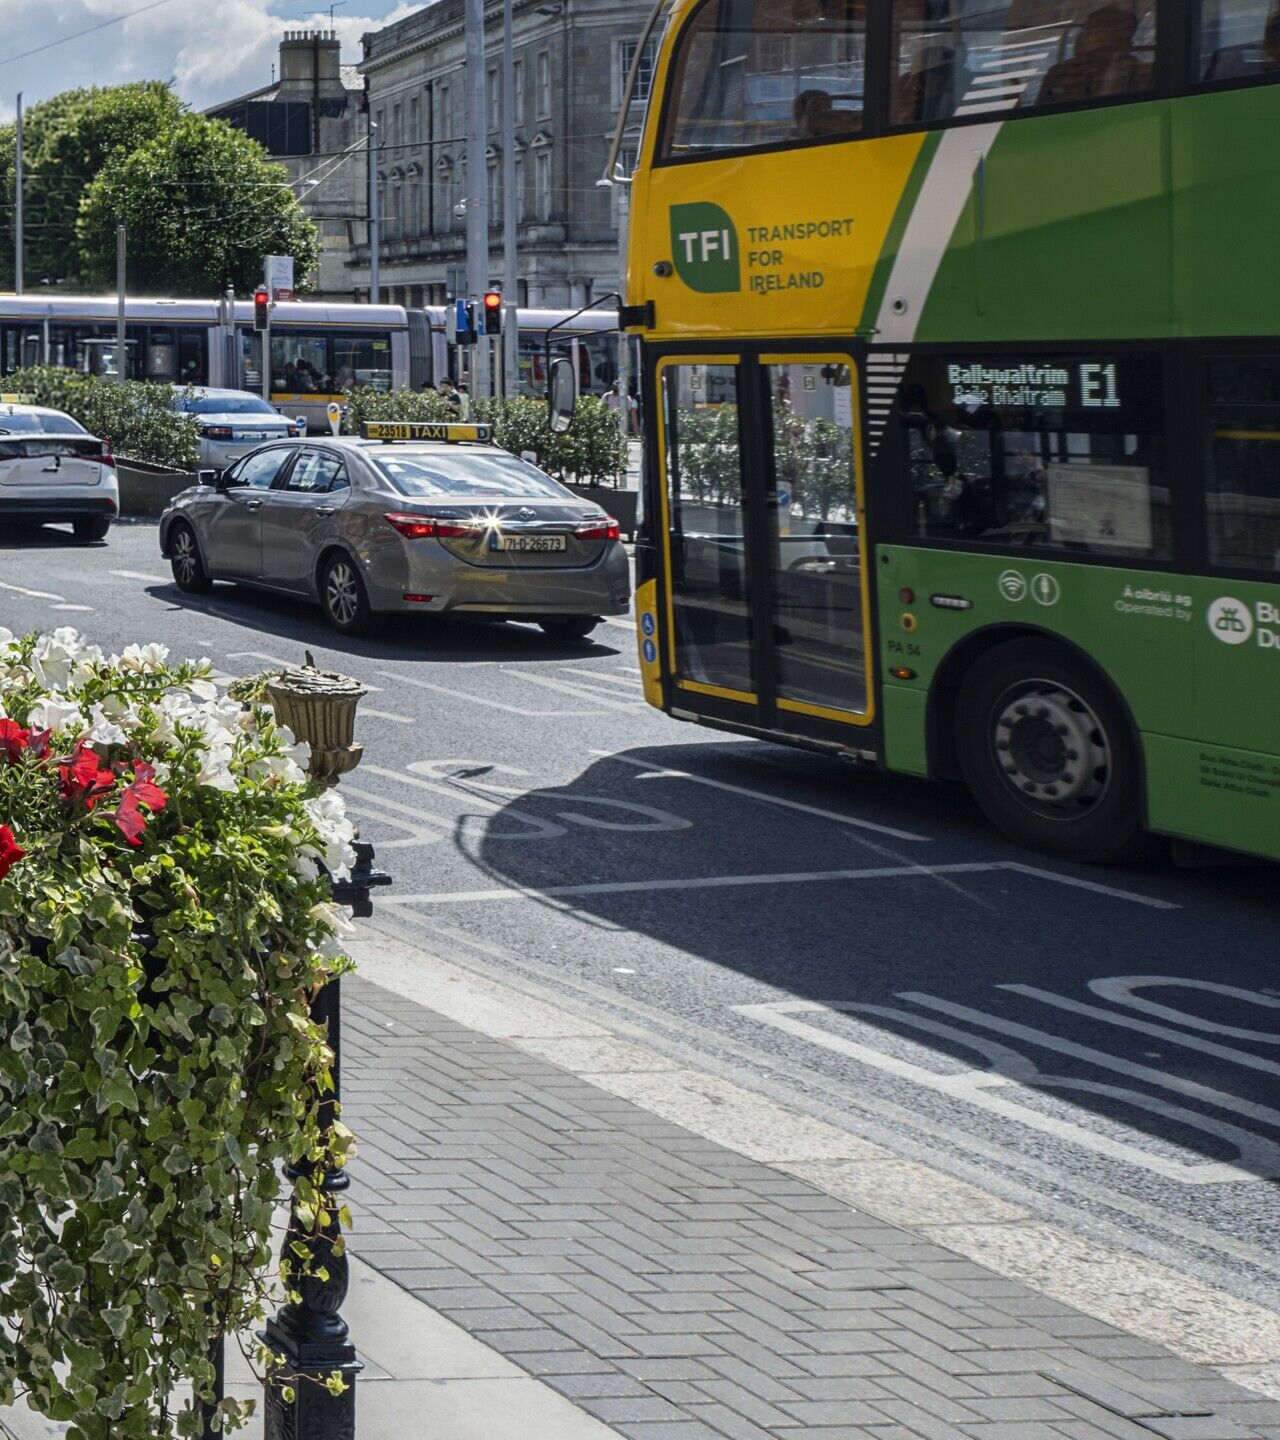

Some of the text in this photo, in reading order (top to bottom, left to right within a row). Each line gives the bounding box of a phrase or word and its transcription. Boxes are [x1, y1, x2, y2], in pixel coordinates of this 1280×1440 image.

[747, 219, 854, 244] TRANSPORT
[679, 229, 730, 262] TFI
[748, 250, 783, 268] FOR
[750, 271, 824, 291] IRELAND
[948, 364, 1069, 384] Ballywaltrim
[1080, 364, 1121, 407] E1
[378, 425, 407, 438] 23518
[412, 425, 446, 438] TAXI
[477, 427, 488, 438] D
[1114, 599, 1192, 622] Operated by
[888, 640, 903, 653] PA
